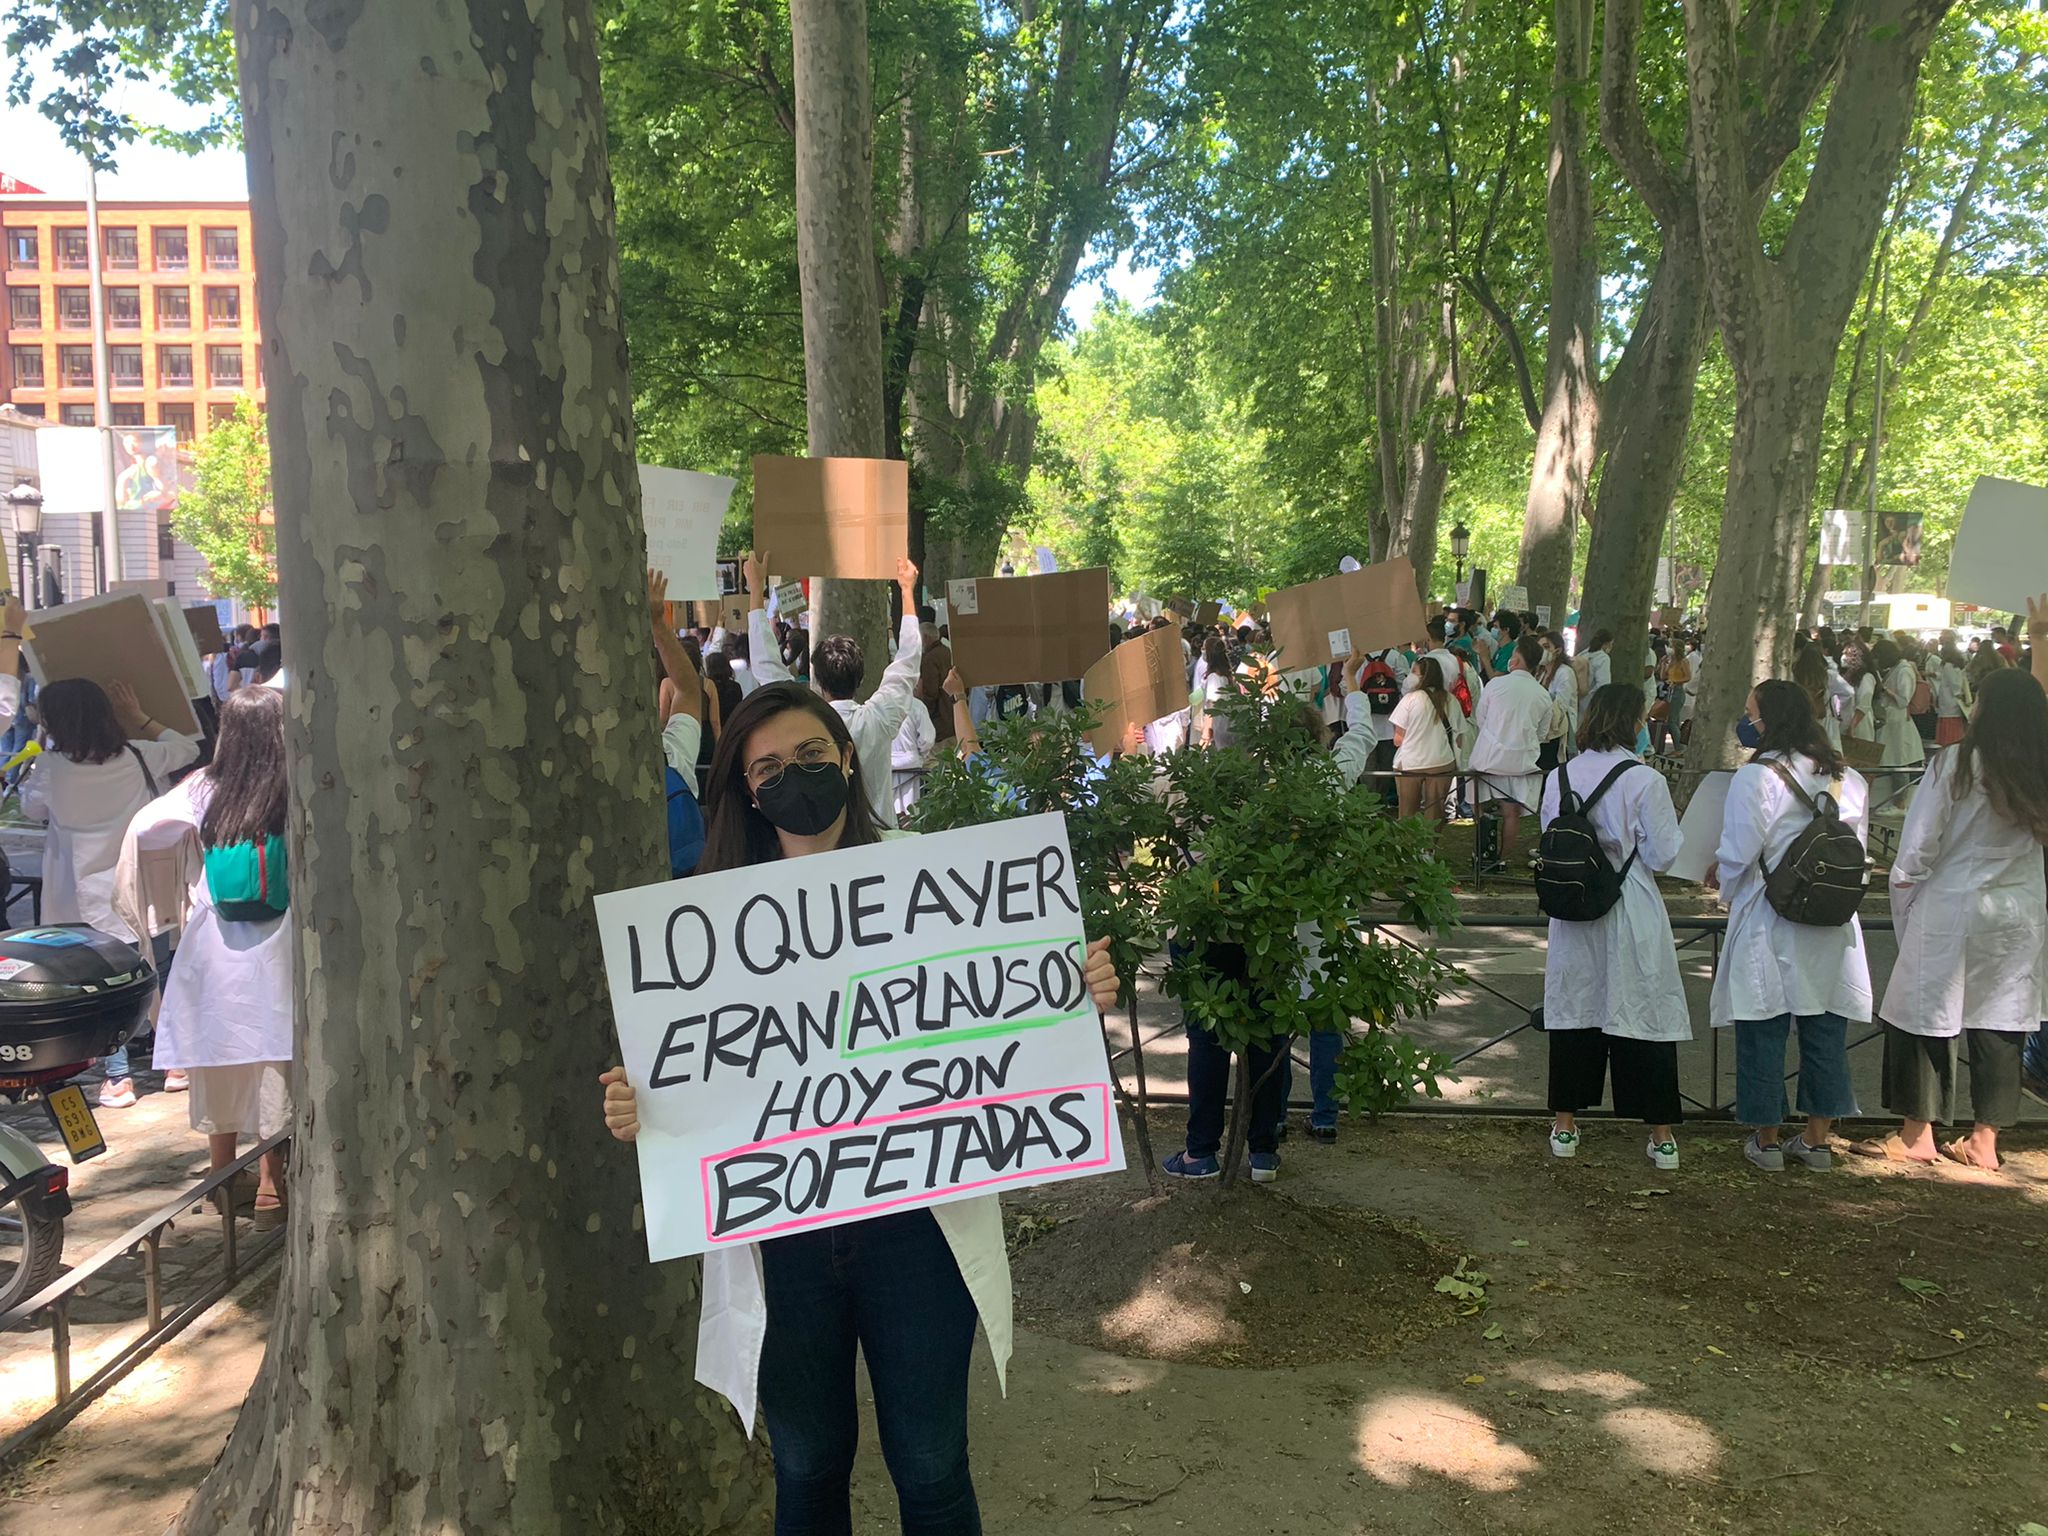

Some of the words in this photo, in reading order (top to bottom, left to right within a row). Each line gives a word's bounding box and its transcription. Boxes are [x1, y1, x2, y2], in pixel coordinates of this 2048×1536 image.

[628, 905, 716, 993] LO
[735, 875, 893, 975] QUE
[904, 846, 1079, 934] AYER
[649, 991, 840, 1089] ERAN
[847, 941, 1087, 1050] APLAUSOS
[753, 1067, 892, 1141] HOY
[899, 1041, 1021, 1111] SON
[713, 1093, 1092, 1236] BOFETADAS
